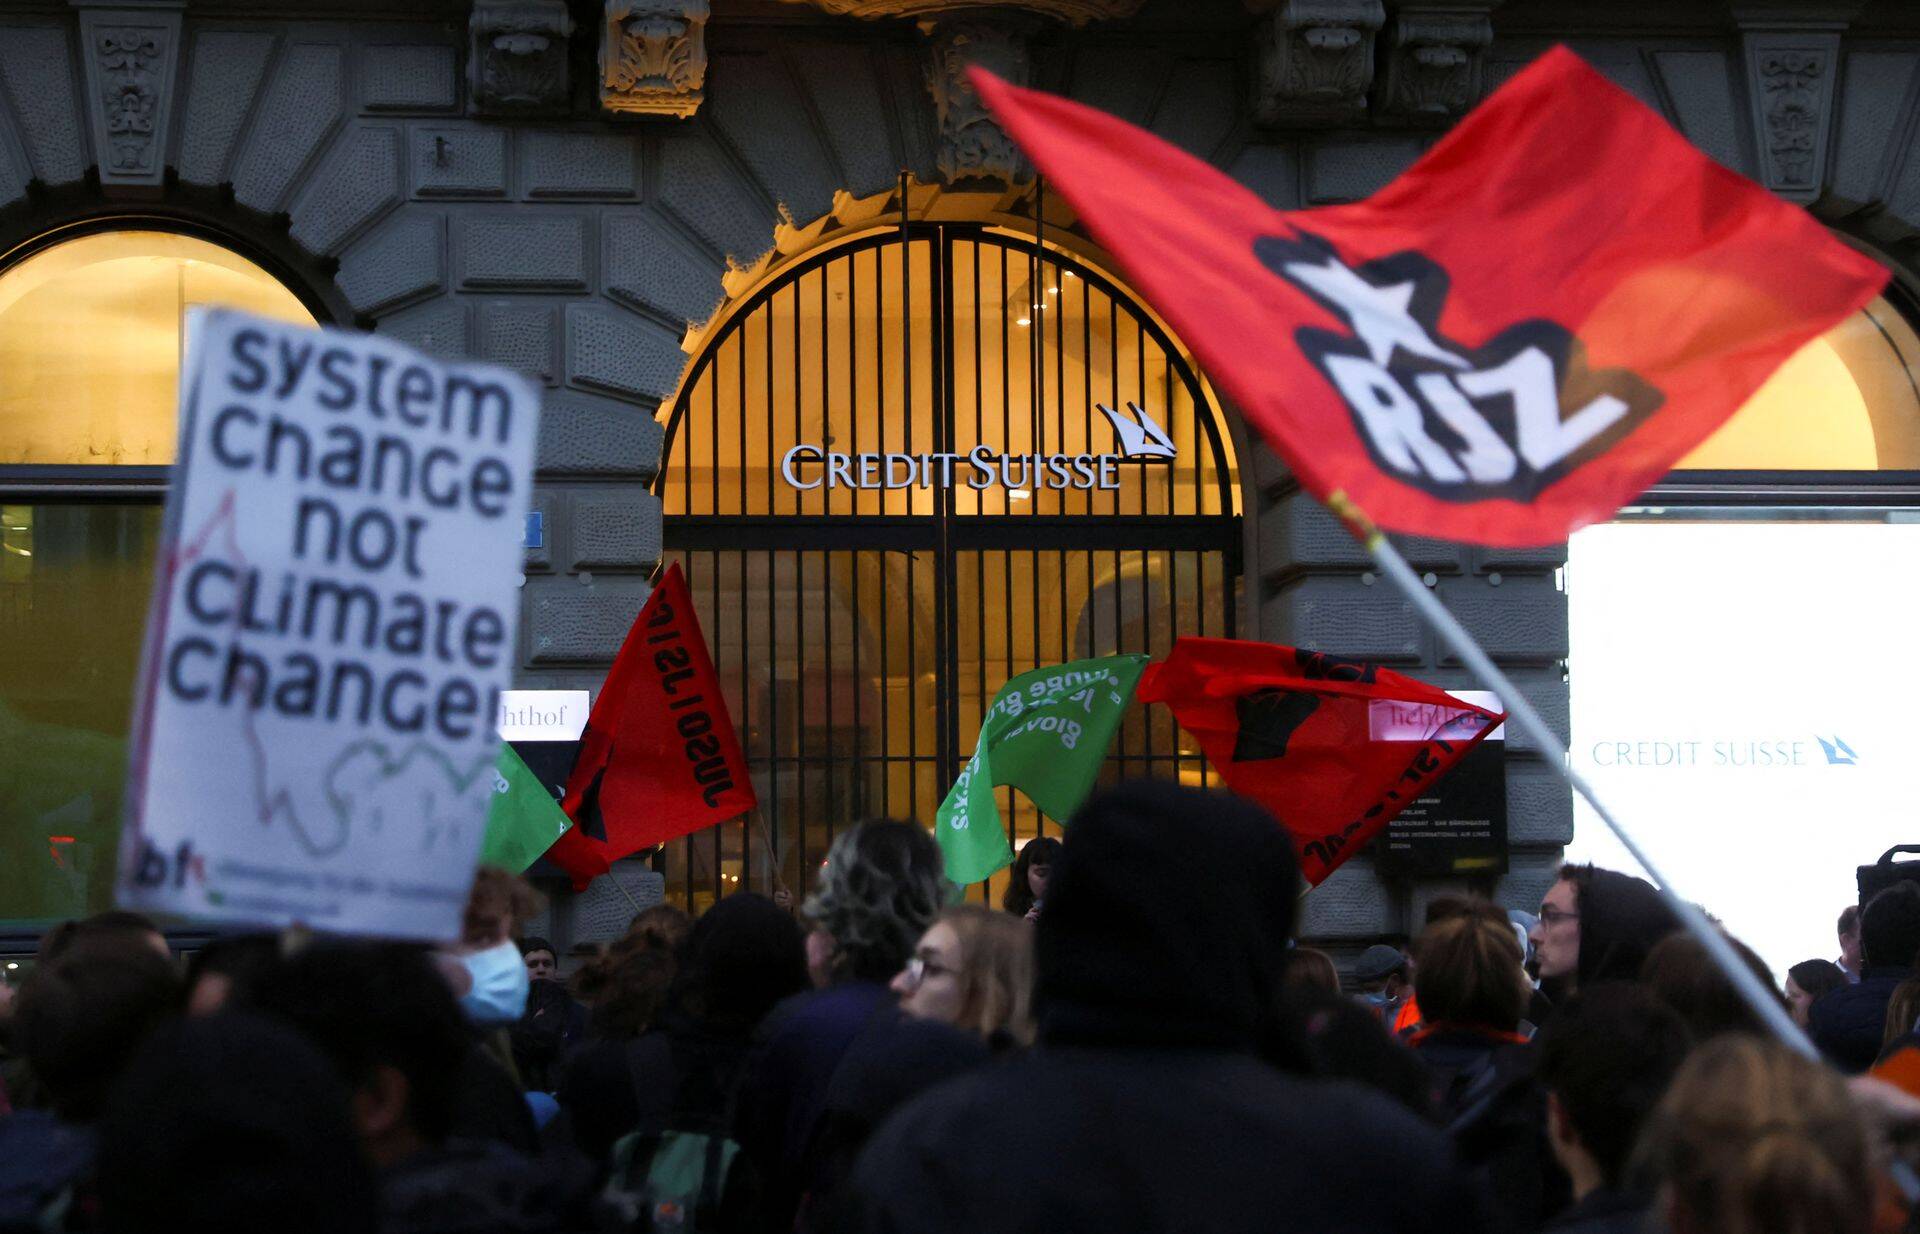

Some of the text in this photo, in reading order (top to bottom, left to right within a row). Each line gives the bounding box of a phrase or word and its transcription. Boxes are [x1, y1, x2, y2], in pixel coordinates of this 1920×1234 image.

[781, 444, 1121, 491] CREDIT SUISSE
[502, 705, 568, 726] hthof
[1592, 741, 1809, 767] CREDIT SUISSE
